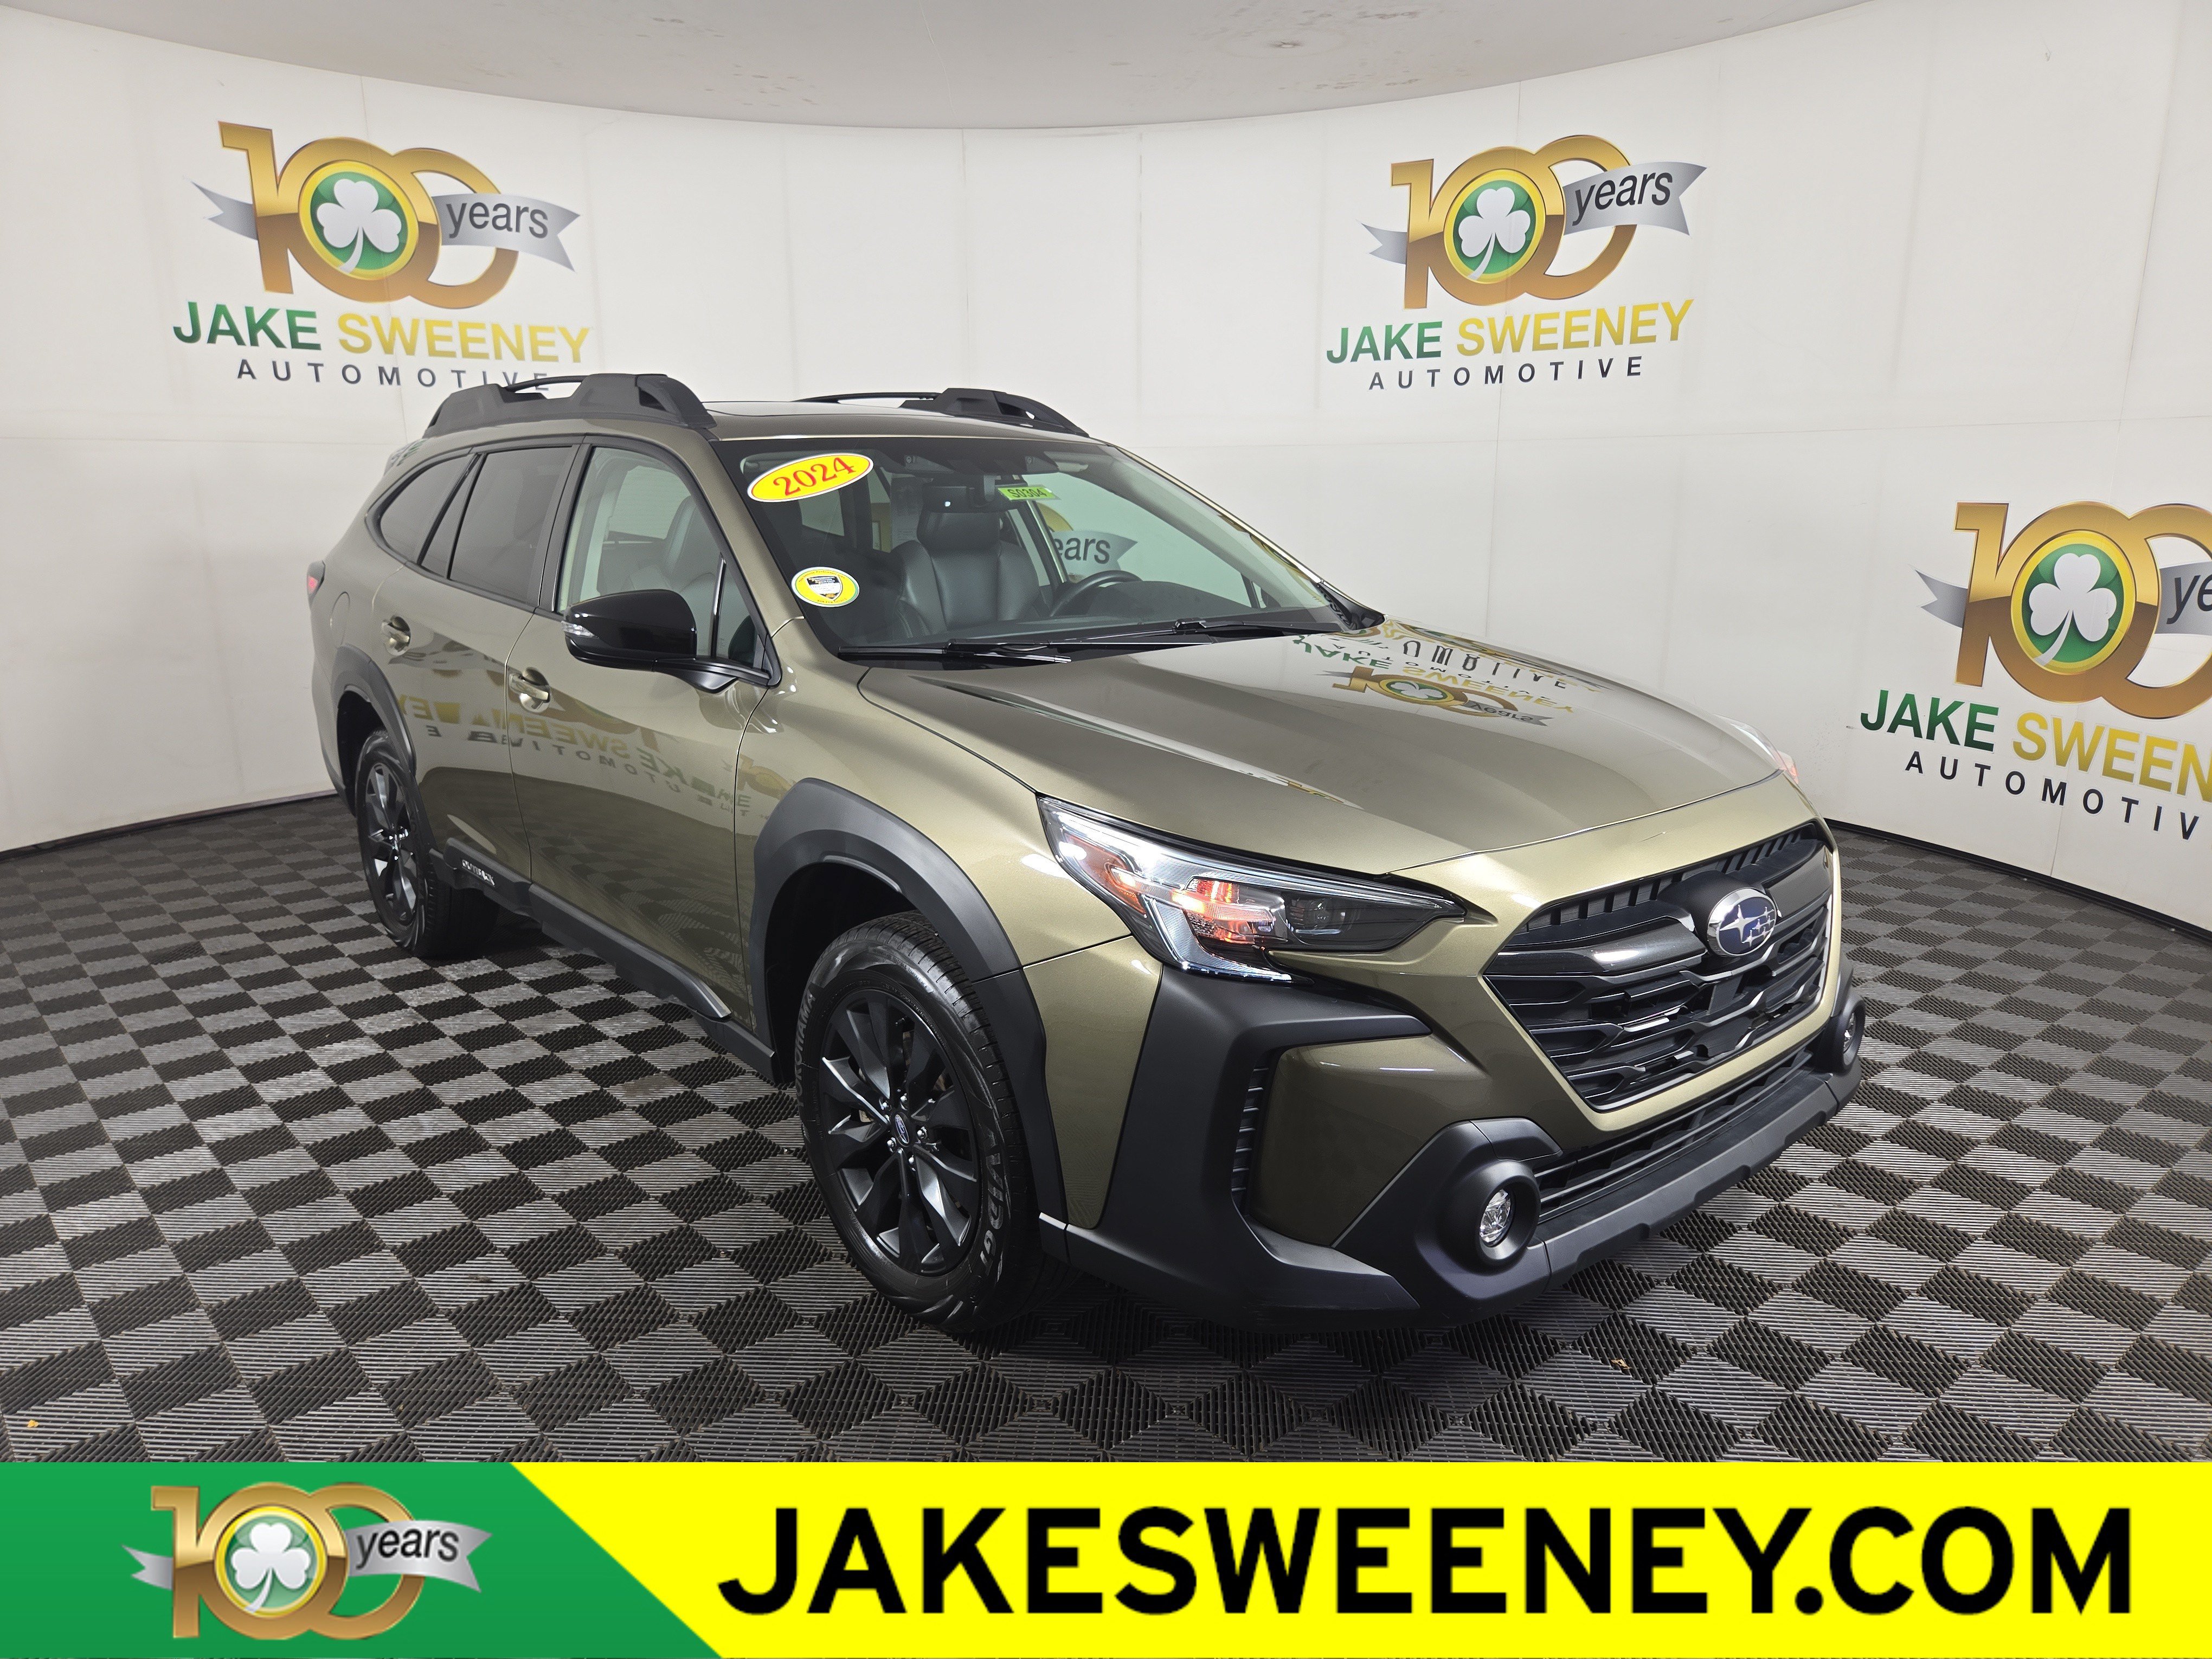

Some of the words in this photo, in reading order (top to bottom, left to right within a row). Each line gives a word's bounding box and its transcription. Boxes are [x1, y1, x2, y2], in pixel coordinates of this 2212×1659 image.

[218, 121, 519, 309] 100
[445, 200, 549, 239] years
[1391, 134, 1637, 309] 100
[1572, 171, 1673, 226] years
[173, 301, 321, 351] JAKE
[337, 312, 589, 363] SWEENEY
[1326, 320, 1443, 364] JAKE
[1457, 298, 1695, 357] SWEENEY
[1368, 356, 1643, 391] AUTOMOTIVE
[773, 457, 856, 496] 2024
[1007, 488, 1047, 499] S0304
[1860, 689, 1999, 752] JAKE
[794, 988, 815, 1107] YOKOHAMA
